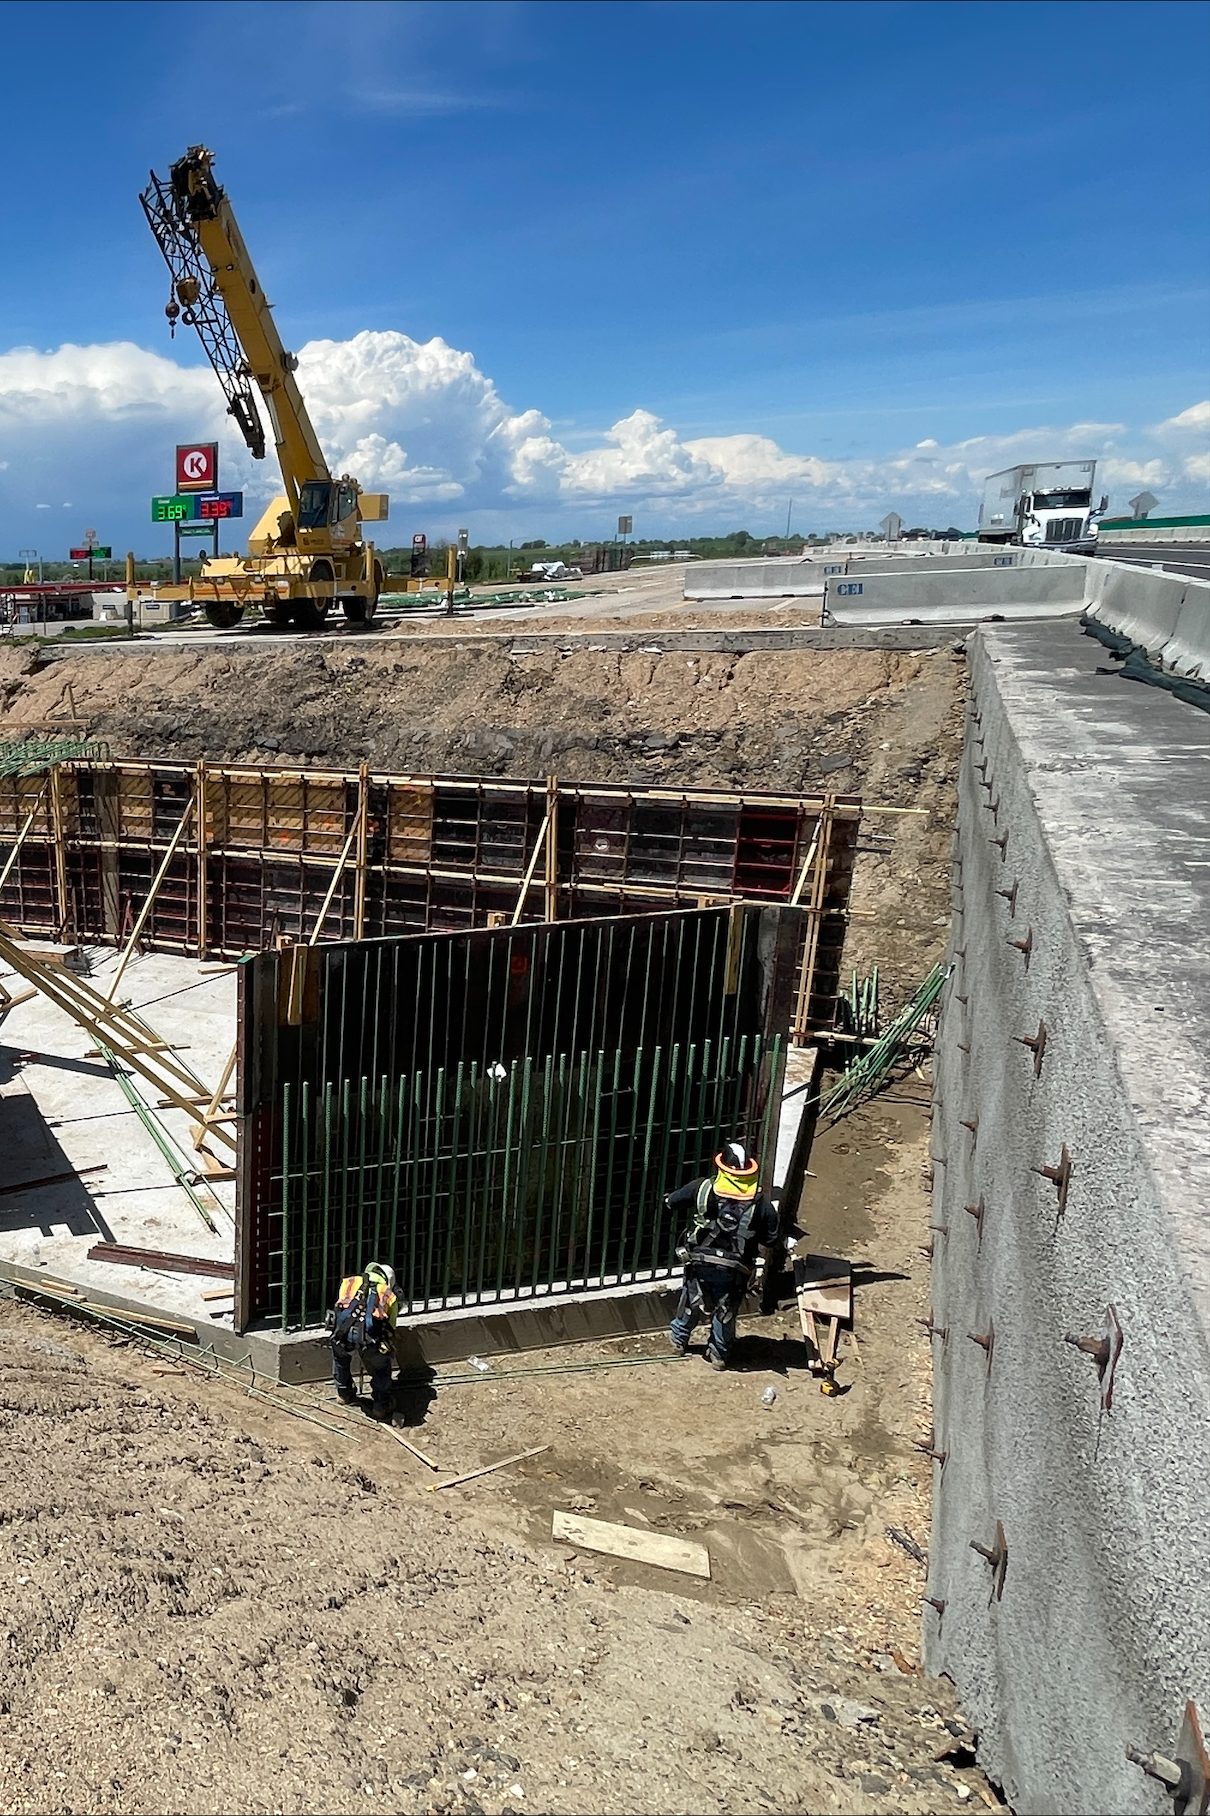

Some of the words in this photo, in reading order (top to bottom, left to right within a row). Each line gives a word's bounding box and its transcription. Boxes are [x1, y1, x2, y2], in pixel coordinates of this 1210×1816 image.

[190, 457, 205, 474] K
[824, 566, 842, 575] CEI
[837, 583, 863, 596] CEI
